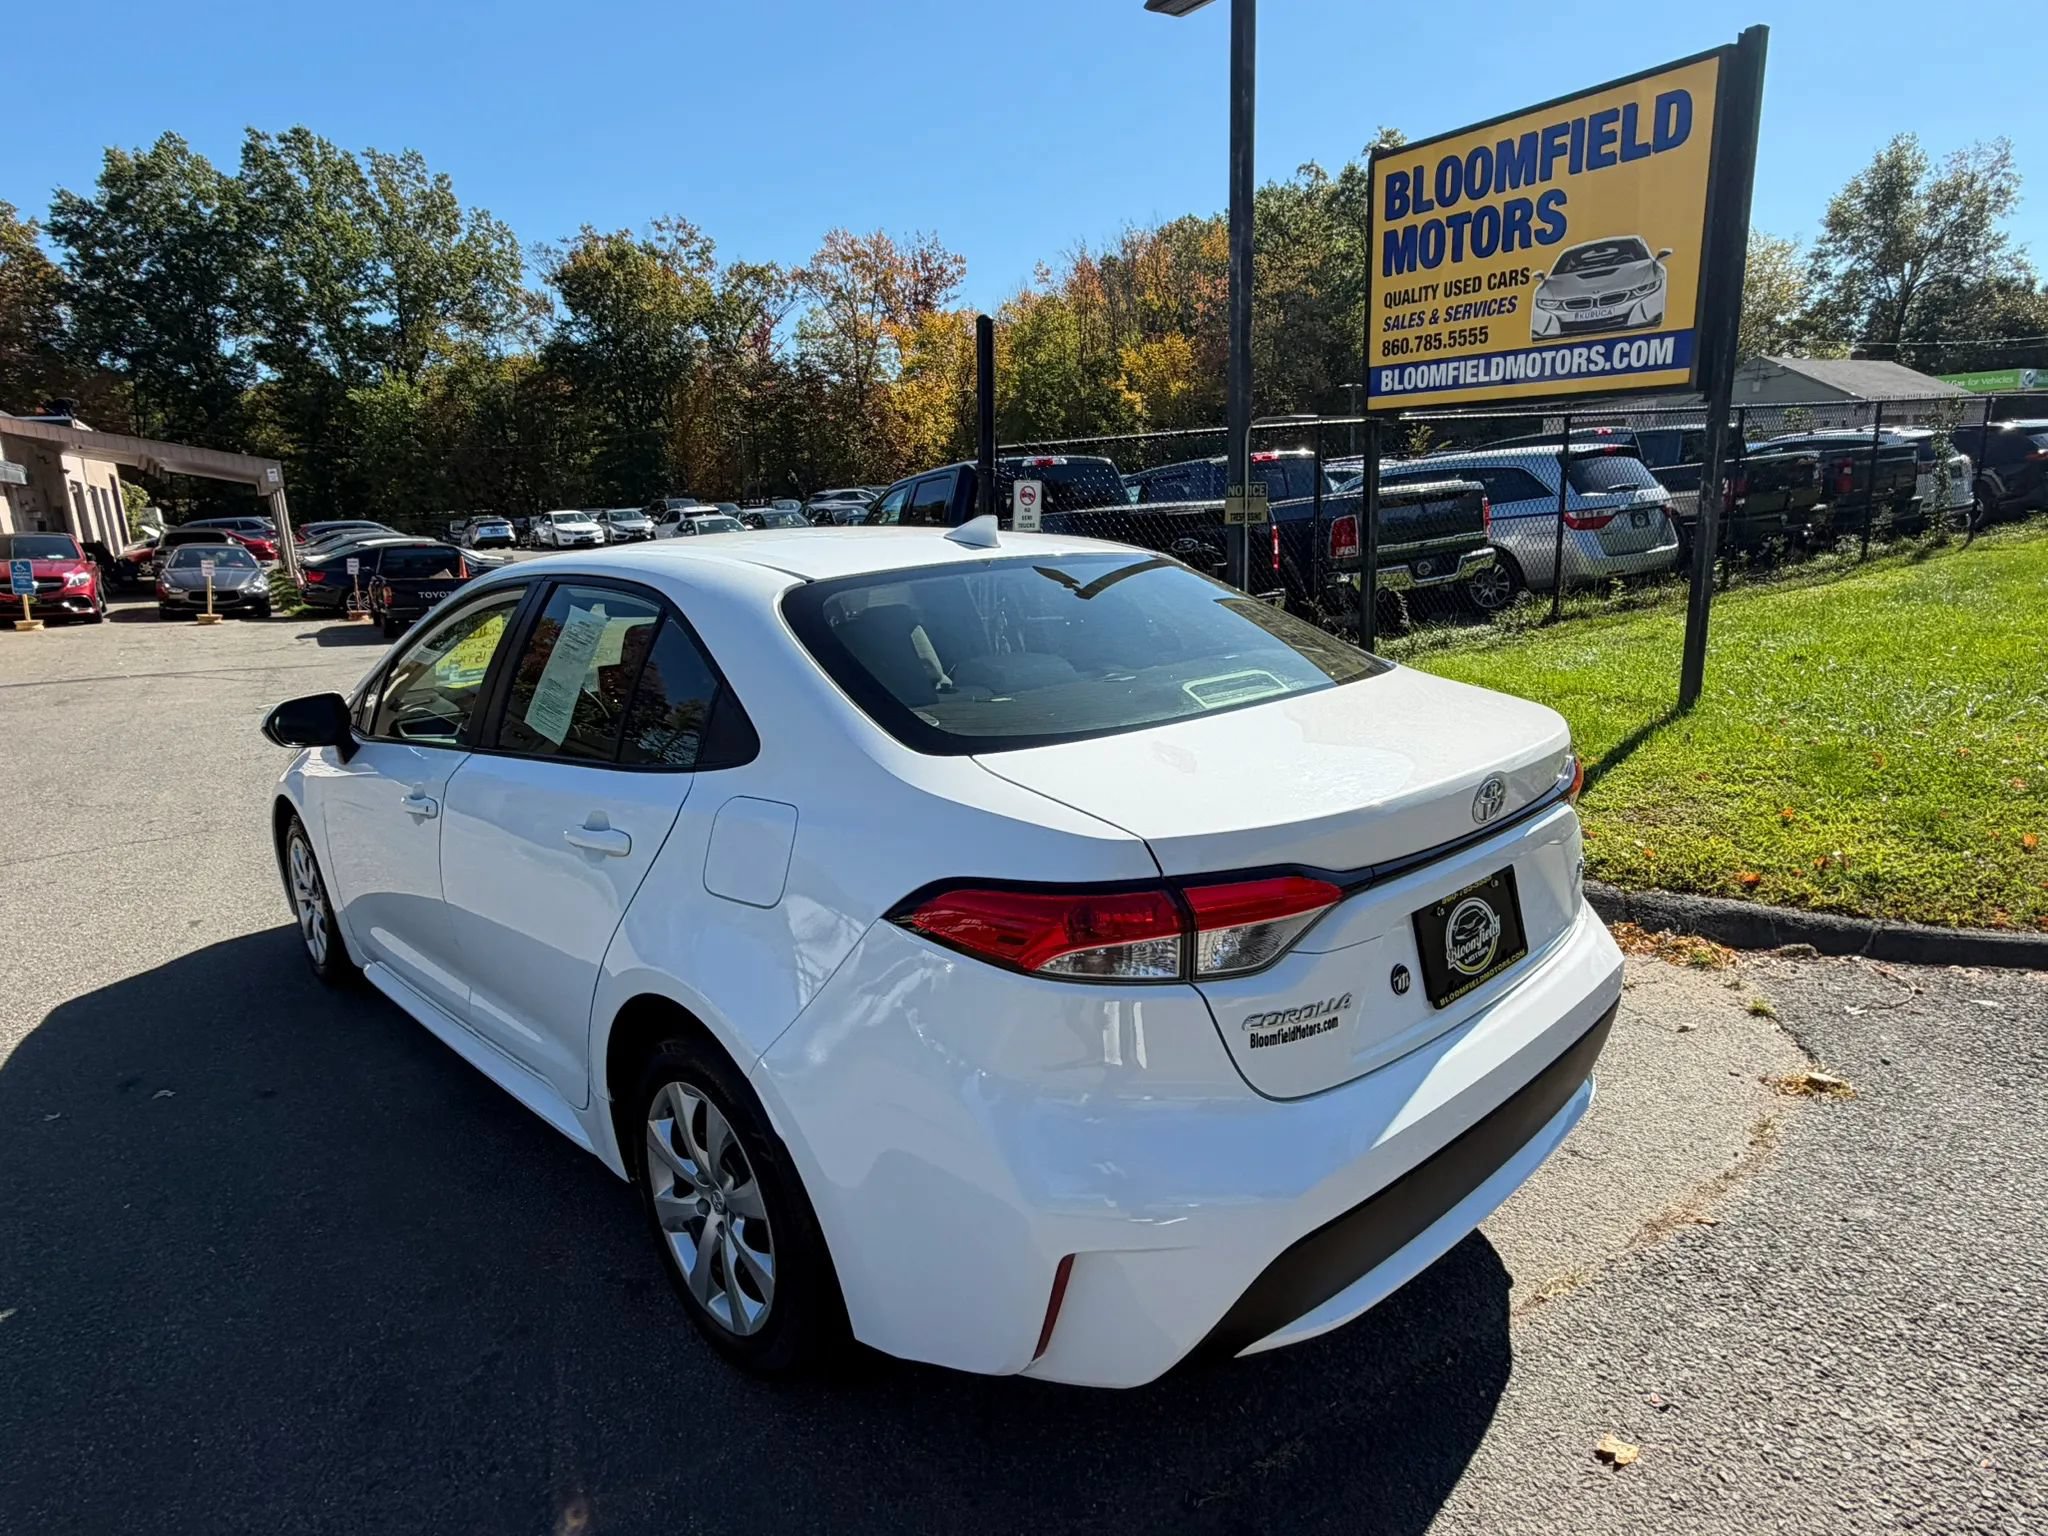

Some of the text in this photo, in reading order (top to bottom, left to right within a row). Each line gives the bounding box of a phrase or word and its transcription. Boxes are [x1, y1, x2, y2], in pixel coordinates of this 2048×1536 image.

[1385, 89, 1693, 222] BLOOMFIELD
[1383, 189, 1567, 277] MOTORS
[1383, 266, 1530, 309] QUALITY USED CARS
[1382, 295, 1518, 332] SALES & SERVICES
[1381, 325, 1489, 357] 860.785.5555
[1380, 337, 1675, 392] BLOOMFIELDMOTORS.COM
[1227, 484, 1266, 497] NOICE
[418, 591, 453, 599] TOYOT
[1440, 949, 1526, 1007] BLOOMFIELDMOTORS.COM
[1241, 991, 1353, 1032] COROLLA
[1250, 1016, 1339, 1049] BloomfieldMotors.com
